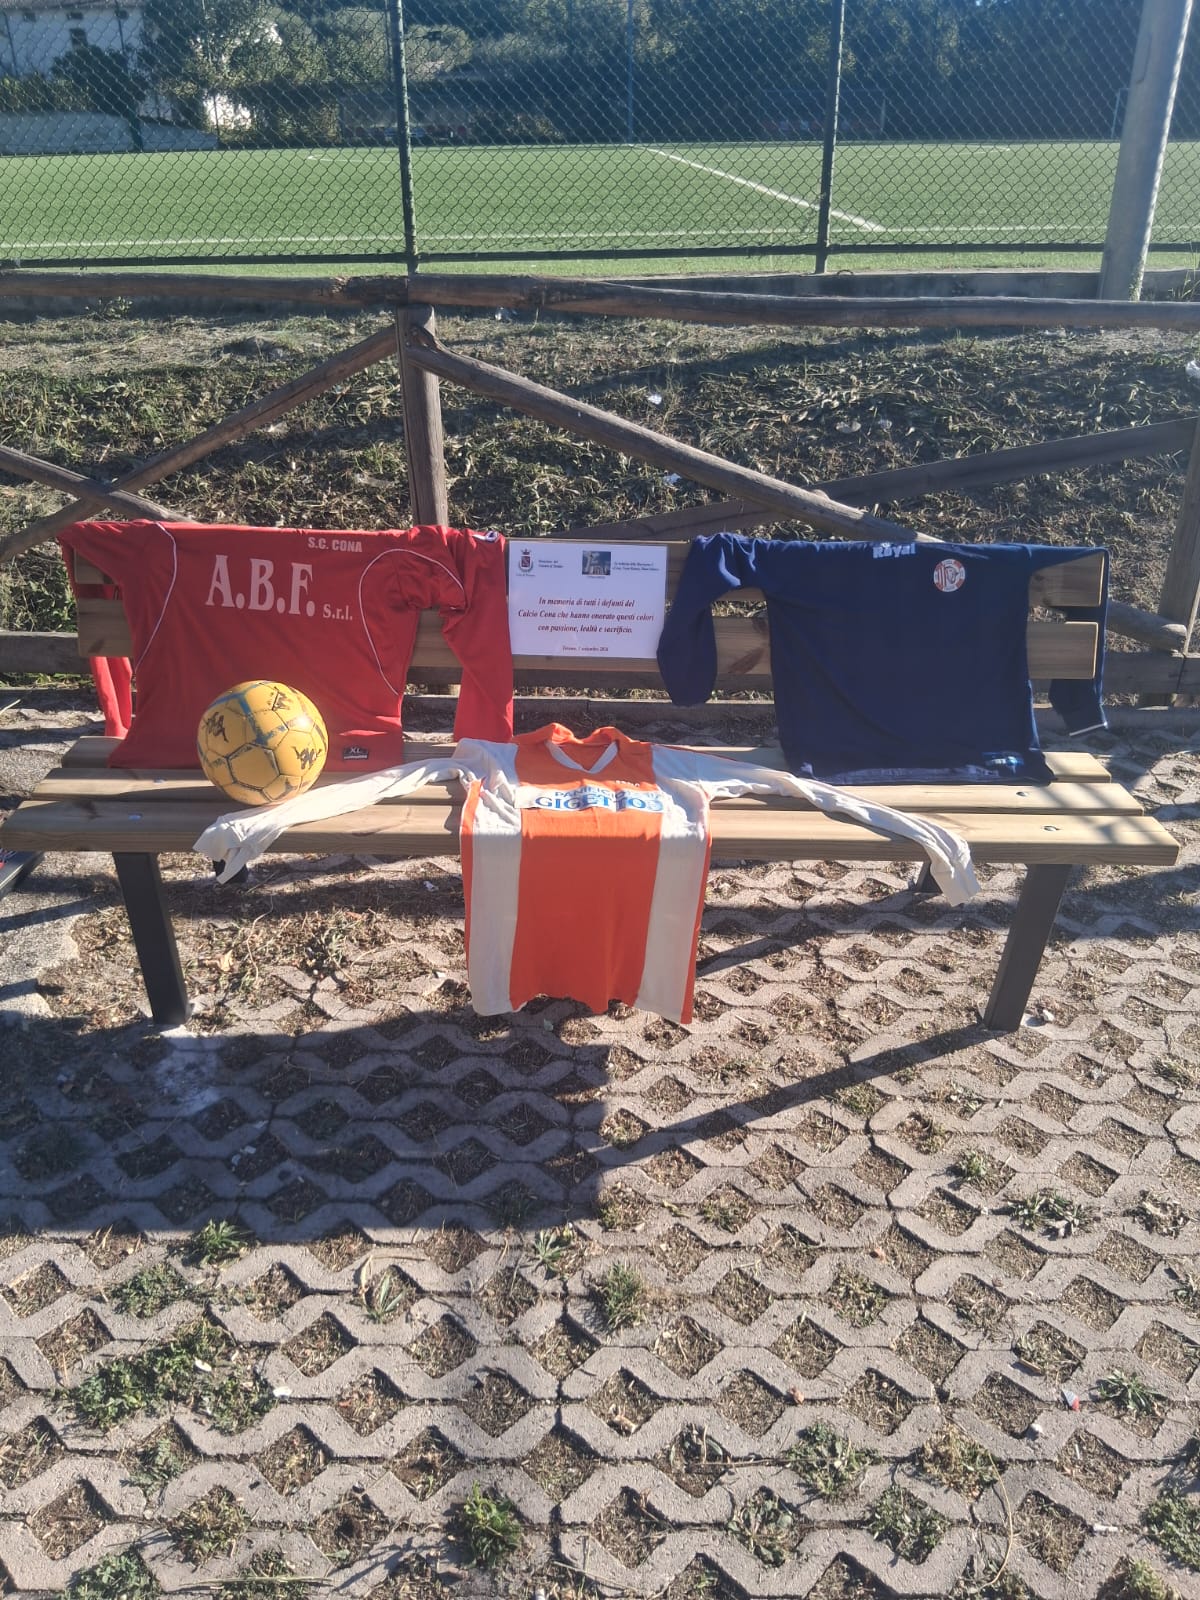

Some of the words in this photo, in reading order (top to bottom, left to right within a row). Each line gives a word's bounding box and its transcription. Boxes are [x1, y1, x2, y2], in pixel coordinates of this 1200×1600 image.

[307, 536, 330, 550] S.C.
[331, 539, 363, 553] CONA
[872, 542, 916, 559] Royal
[205, 554, 316, 617] A.B.F.
[322, 603, 353, 621] S.r.l.
[538, 596, 546, 605] In
[547, 598, 575, 606] memoria
[576, 597, 583, 606] di
[583, 598, 597, 607] tutti
[602, 599, 624, 609] defunti
[624, 599, 635, 608] del
[518, 609, 538, 618] Calcio
[539, 610, 556, 618] Cona
[557, 610, 568, 619] che
[537, 624, 549, 632] con
